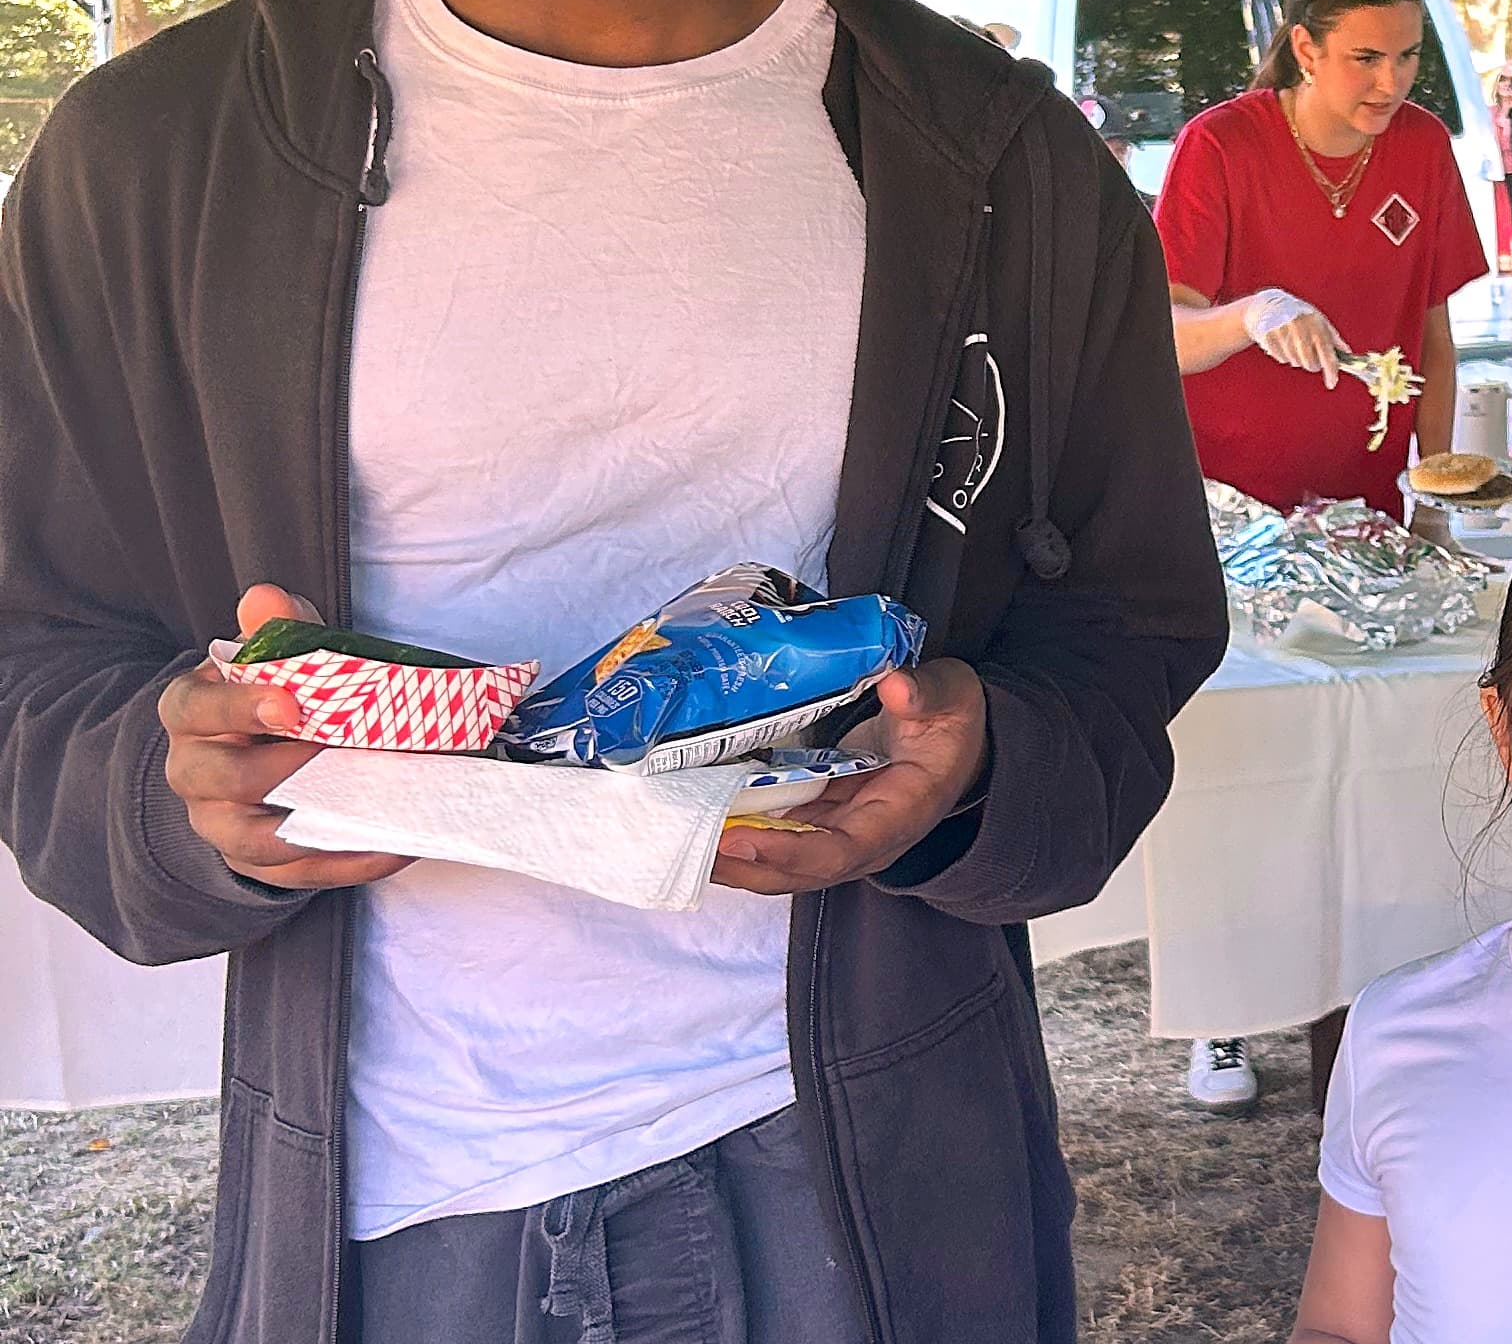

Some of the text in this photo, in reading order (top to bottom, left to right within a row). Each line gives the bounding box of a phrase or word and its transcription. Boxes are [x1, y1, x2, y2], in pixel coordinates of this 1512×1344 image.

[709, 602, 748, 626] RANCH
[730, 600, 761, 624] COOL
[607, 679, 639, 701] 150
